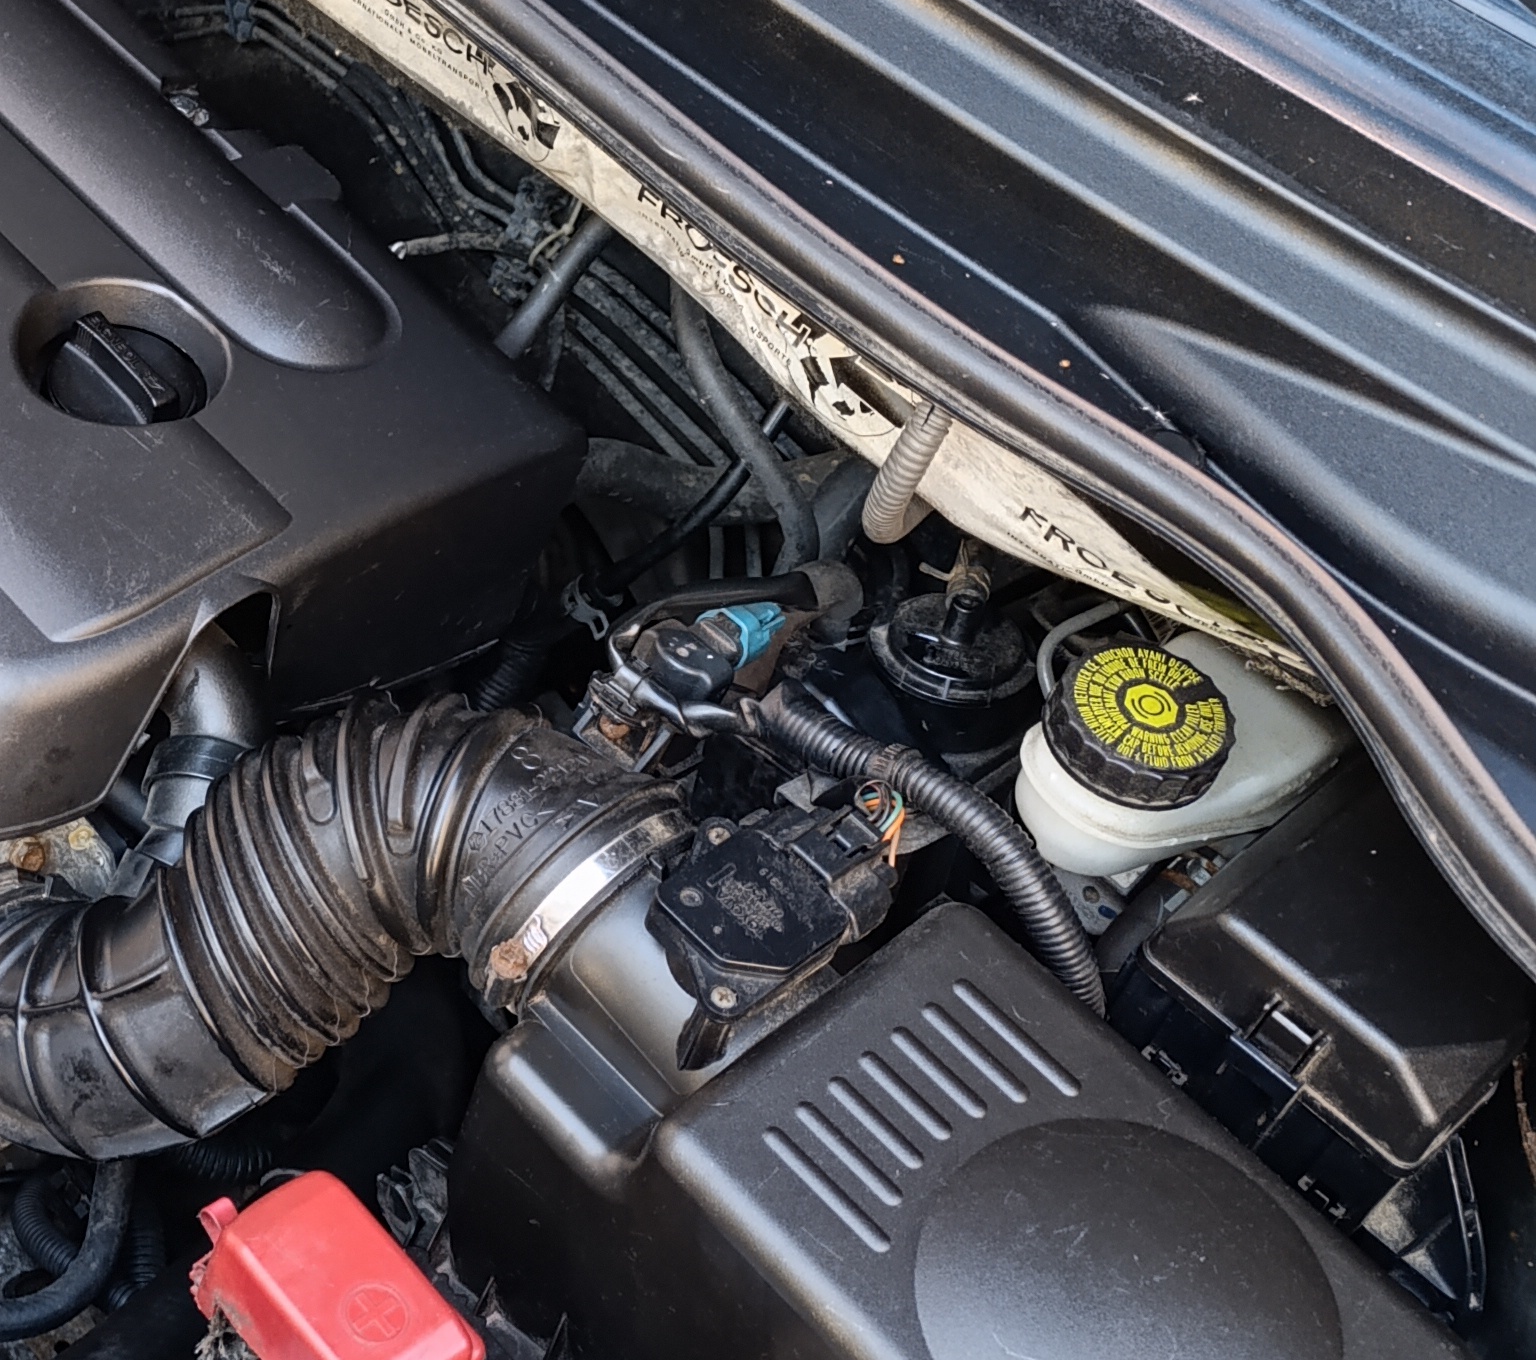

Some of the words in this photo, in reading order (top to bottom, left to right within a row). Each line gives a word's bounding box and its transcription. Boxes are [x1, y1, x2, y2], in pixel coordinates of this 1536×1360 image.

[86, 313, 125, 353] ENGINE
[120, 348, 142, 369] OIL
[1084, 659, 1099, 671] CE
[1093, 647, 1134, 664] BOUCHON
[1137, 648, 1165, 663] AVANT
[1128, 657, 1142, 667] DE
[1143, 658, 1167, 673] FREIN
[1168, 668, 1184, 681] DOT
[1074, 667, 1093, 704] NETTOYER
[1103, 688, 1131, 729] PROVENANT
[1118, 667, 1145, 680] BIDON
[1078, 705, 1115, 744] ATTENTION
[1130, 725, 1170, 744] WARNING
[1169, 721, 1194, 742] CLEAN
[1184, 703, 1199, 728] FILLER
[1208, 697, 1226, 735] CONTAINER
[1116, 744, 1133, 757] DOT
[1122, 735, 1140, 748] CAP
[1141, 739, 1174, 756] BEFORE
[1194, 751, 1204, 762] A
[1200, 733, 1223, 758] SEALED
[1143, 754, 1169, 767] FLUID
[1170, 755, 1197, 767] FROM
